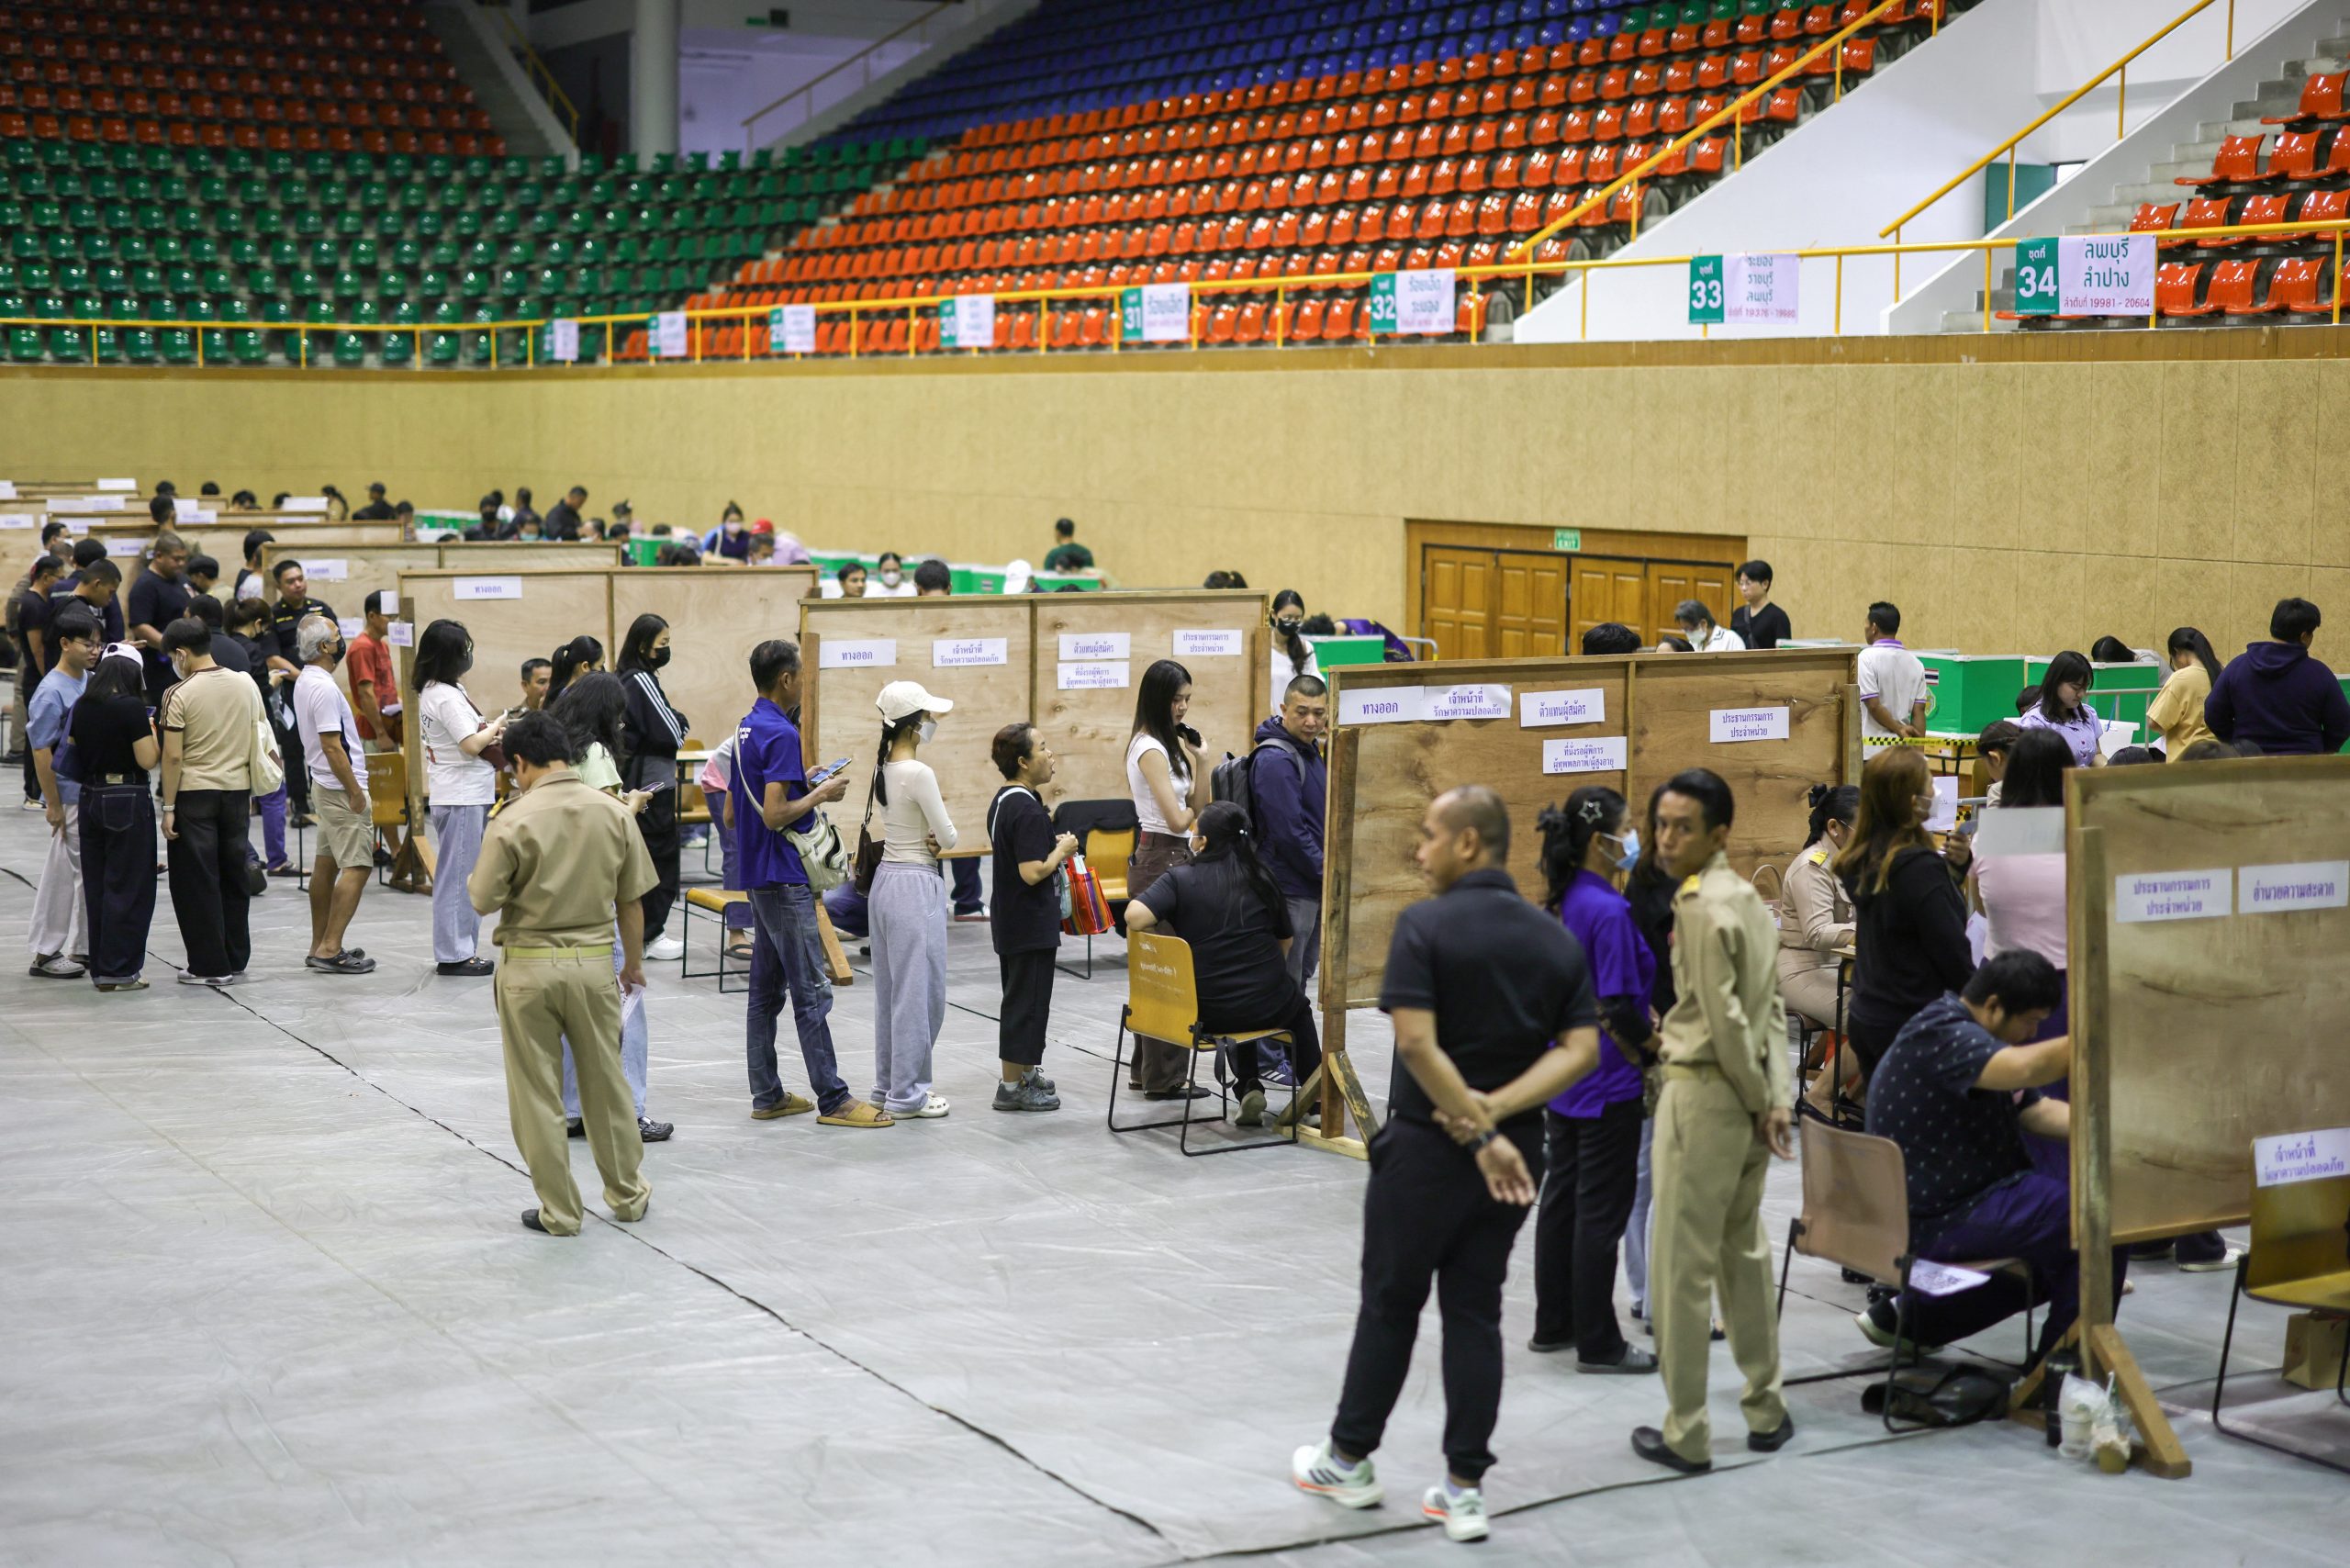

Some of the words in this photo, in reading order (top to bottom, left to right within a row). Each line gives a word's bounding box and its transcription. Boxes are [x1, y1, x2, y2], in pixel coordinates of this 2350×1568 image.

[2029, 244, 2046, 262] ชุดที่
[2085, 237, 2130, 264] ลพบุรี
[2019, 265, 2058, 298] 34
[2084, 266, 2130, 287] ลำปาง
[1691, 280, 1722, 309] 33
[2090, 297, 2115, 308] 19981
[2124, 297, 2150, 308] 20604
[1371, 294, 1396, 320] 32
[1125, 306, 1142, 330] 31
[841, 650, 873, 661] ทางออก
[953, 640, 983, 655] เจ้าหน้าที่
[939, 654, 1000, 665] รักษาความปลอดภัย
[1449, 687, 1483, 704] เจ้าหน้าที่
[1362, 701, 1399, 715] ทางออก
[1434, 702, 1502, 718] รักษาความปลอดภัย
[1539, 700, 1586, 722] ตัวแทนผู้สมัคร
[1722, 711, 1774, 724] ประธานกรรมการ
[1730, 725, 1769, 738] ประจำหน่วย
[2133, 879, 2210, 895] ประธานกรรมการ
[2147, 897, 2202, 916] ประจำหน่วย
